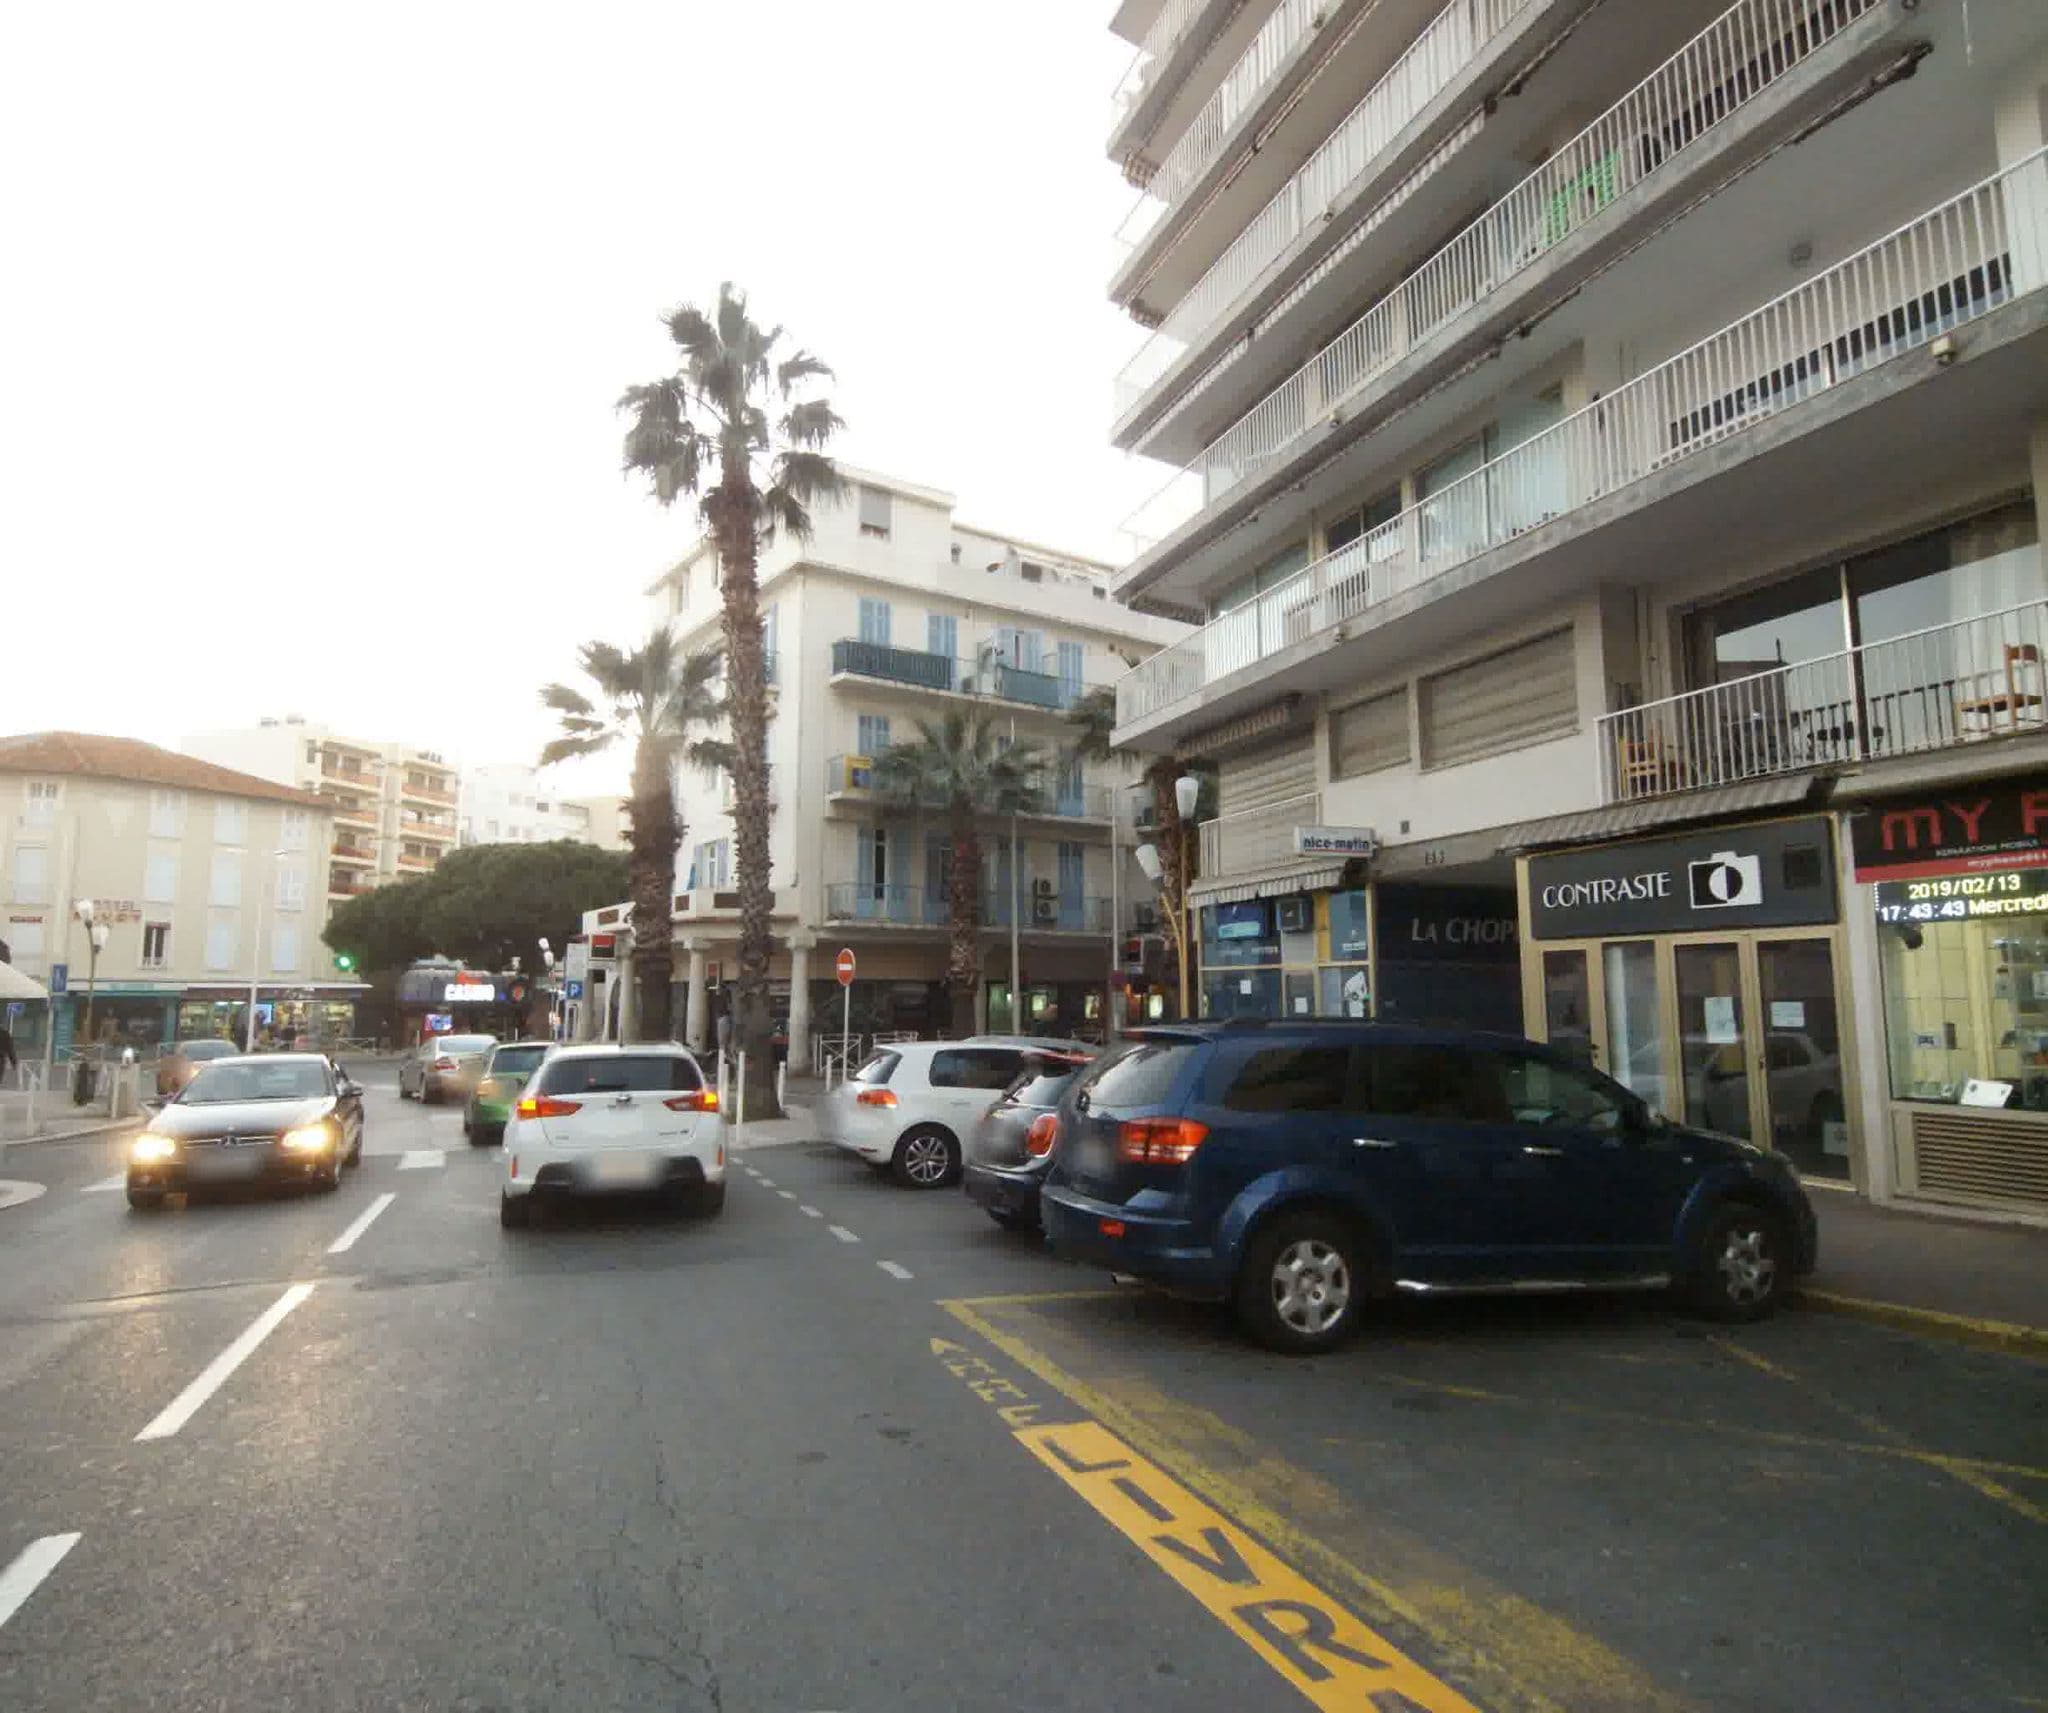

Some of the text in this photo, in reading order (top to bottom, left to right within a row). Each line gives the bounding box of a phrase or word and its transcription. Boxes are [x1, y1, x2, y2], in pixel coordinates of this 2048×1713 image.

[1542, 871, 1672, 909] CONTRASTE
[1908, 874, 2021, 899] 2019/02/13
[1880, 900, 1965, 922] 17:43:43
[1445, 917, 1520, 943] CHOP
